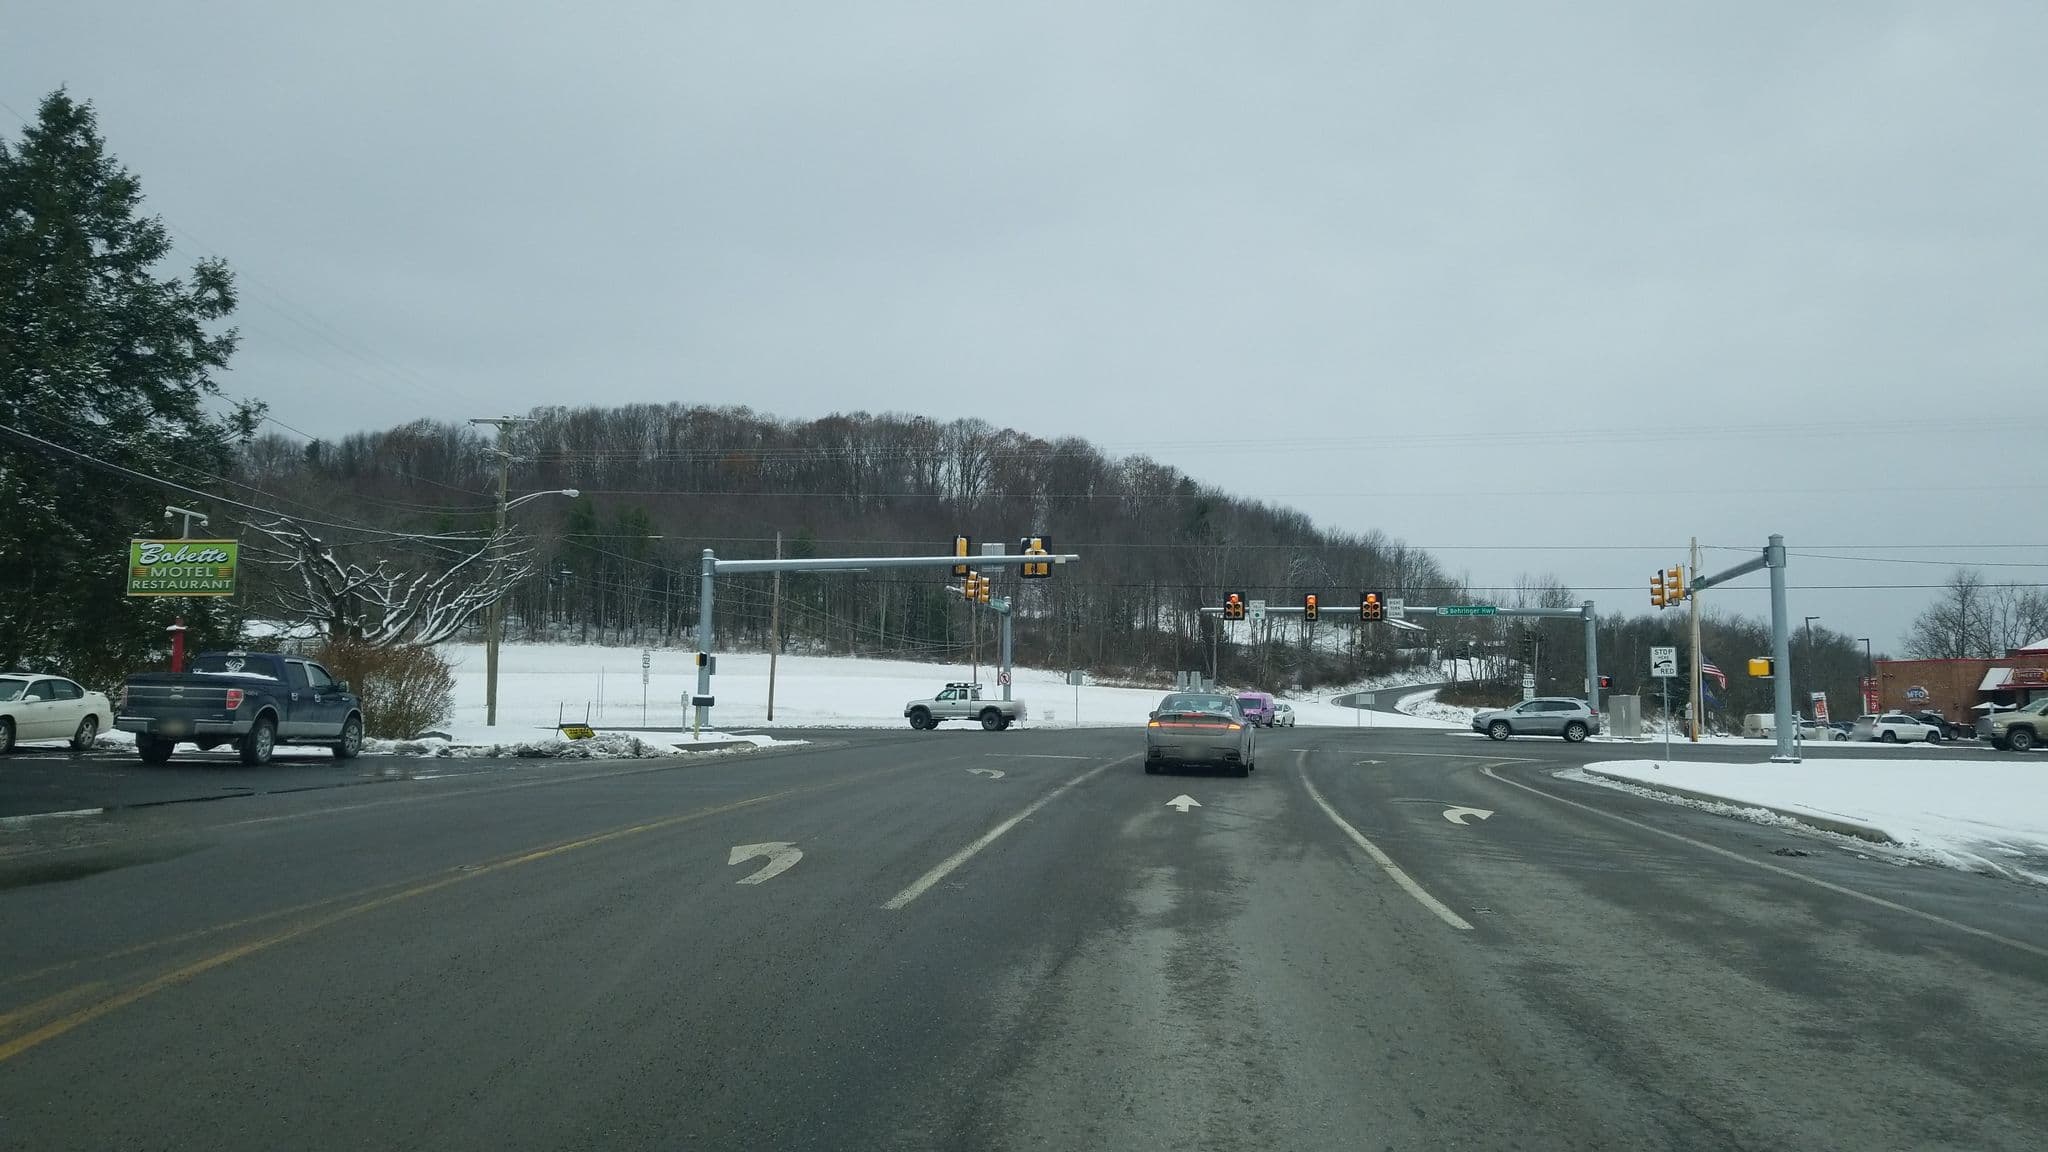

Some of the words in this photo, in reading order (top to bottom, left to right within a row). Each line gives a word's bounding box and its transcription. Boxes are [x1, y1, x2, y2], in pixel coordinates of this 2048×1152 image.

[139, 542, 228, 565] Bobette
[150, 566, 214, 578] MOTEL
[132, 579, 231, 589] RESTAURANT
